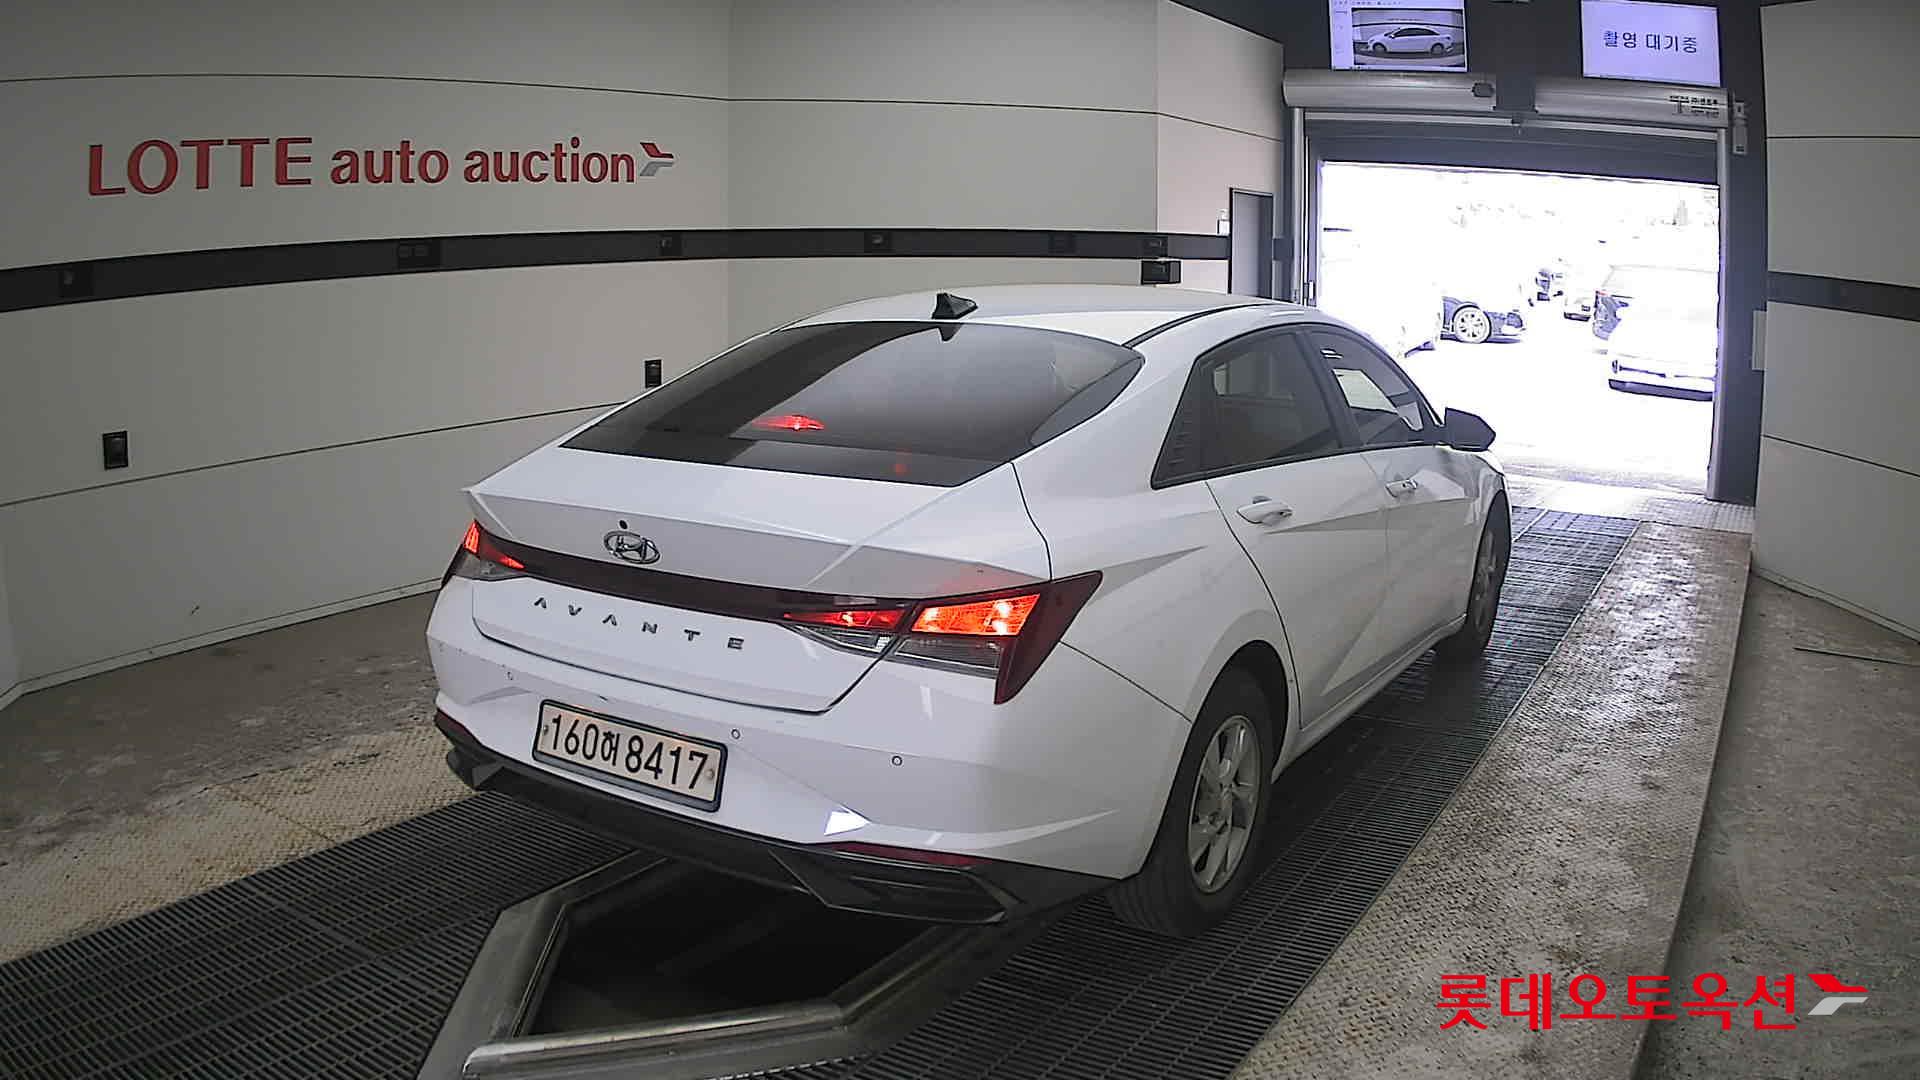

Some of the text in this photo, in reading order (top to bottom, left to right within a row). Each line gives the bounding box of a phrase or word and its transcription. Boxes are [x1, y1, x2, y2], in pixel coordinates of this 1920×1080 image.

[1646, 33, 1698, 54] 대기중
[87, 136, 636, 196] LOTTE auto auction
[533, 596, 745, 651] AVANTE
